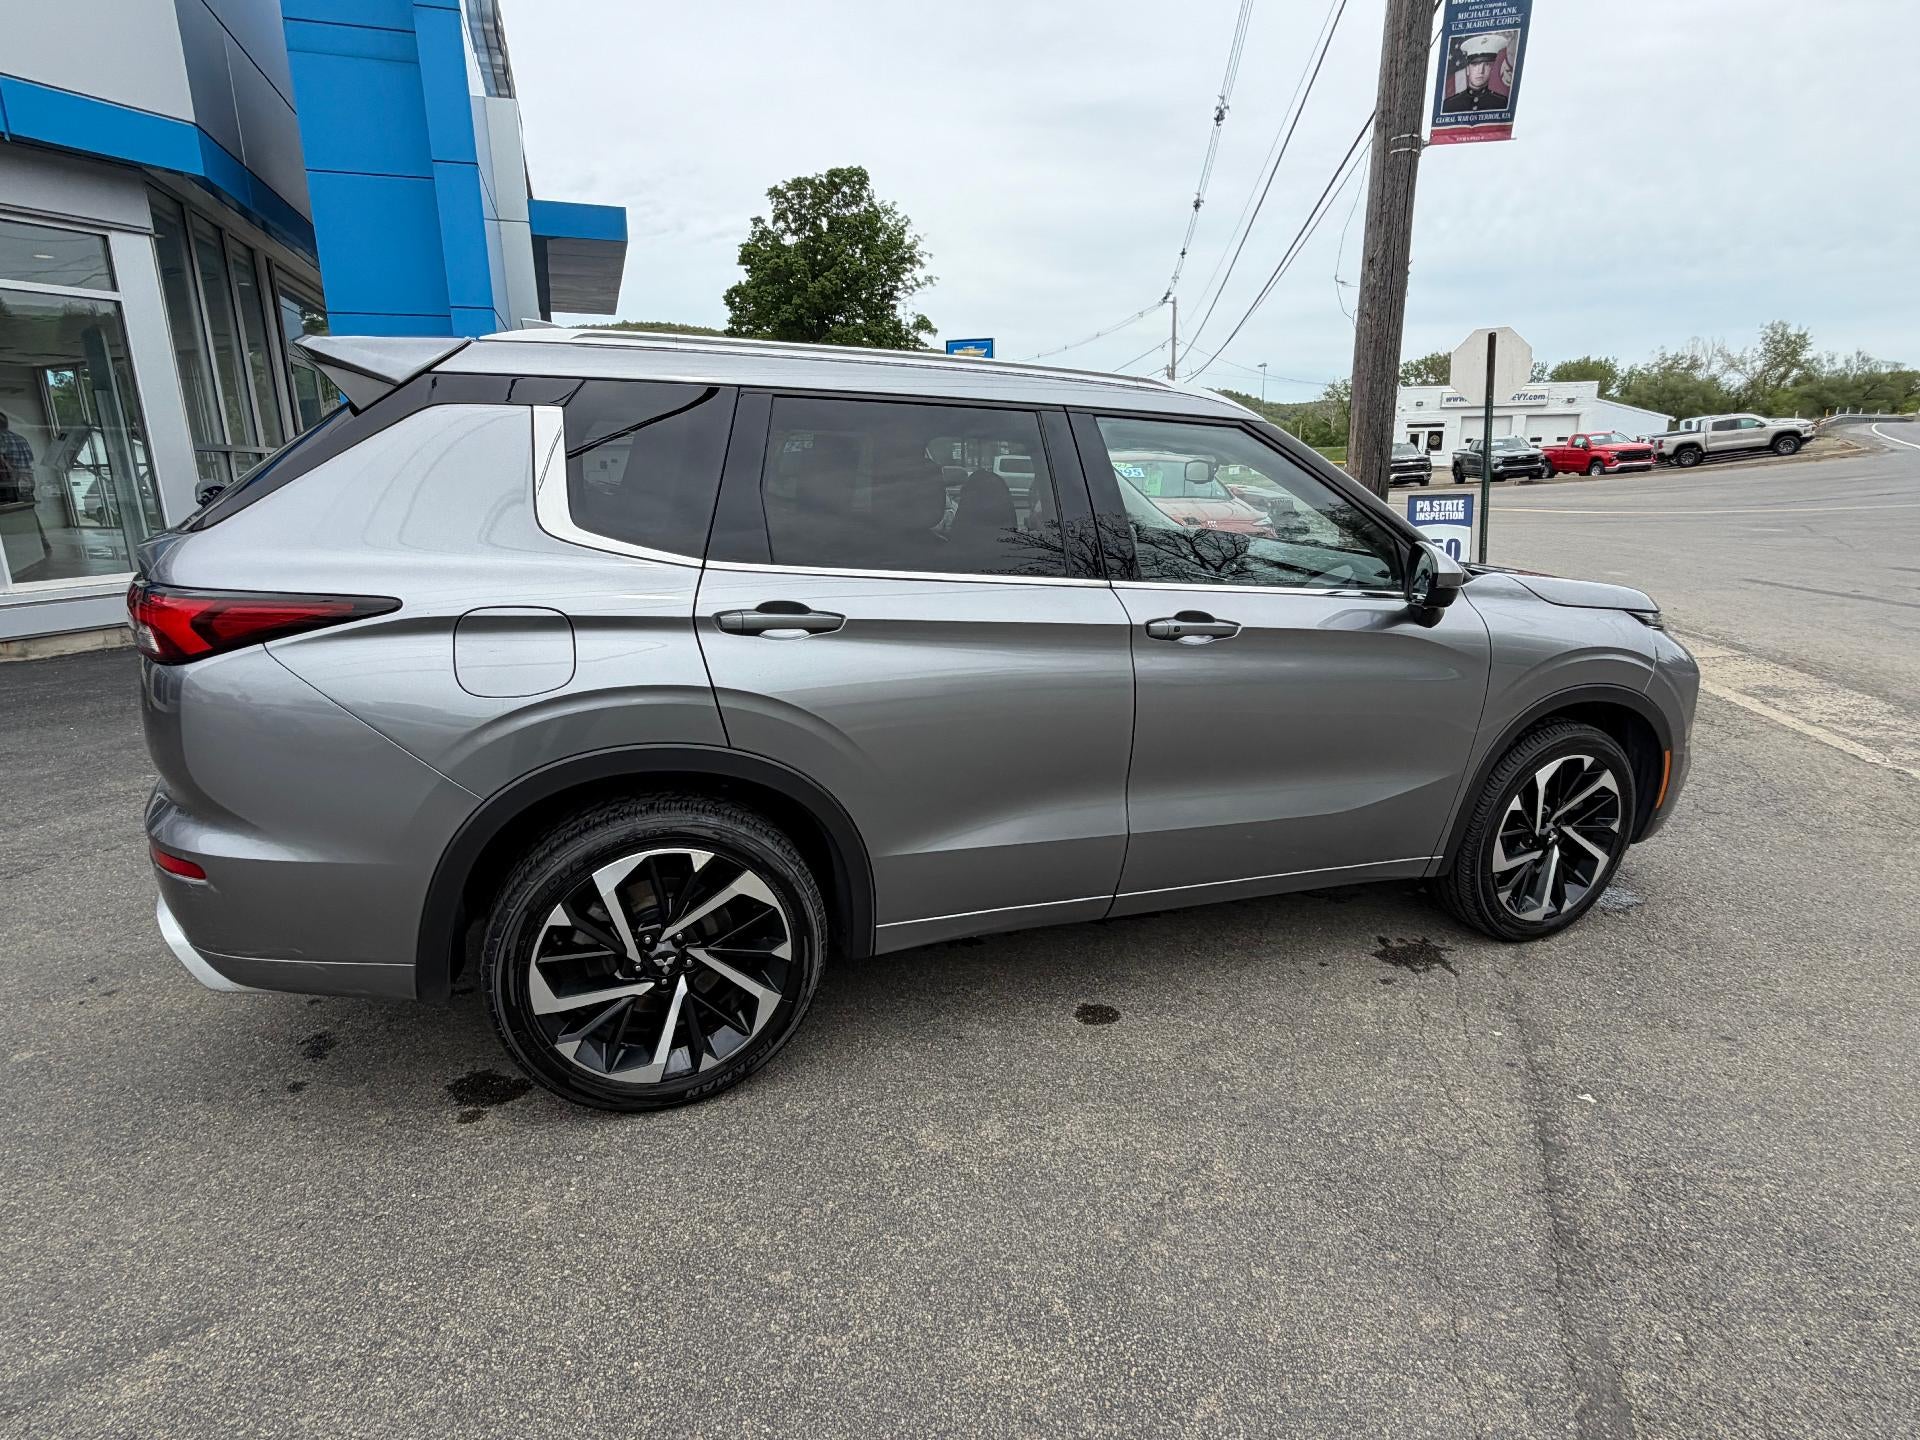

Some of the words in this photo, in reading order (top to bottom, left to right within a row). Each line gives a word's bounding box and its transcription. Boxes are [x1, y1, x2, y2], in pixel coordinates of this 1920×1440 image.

[1457, 9, 1491, 20] MICHAEL
[1492, 6, 1517, 16] PLANK
[1452, 23, 1465, 31] U.S.
[1465, 19, 1495, 30] MARINE
[1496, 16, 1521, 26] CORPS
[1416, 500, 1431, 512] PA
[1432, 499, 1465, 512] STATE
[1415, 511, 1465, 521] INSPECTION
